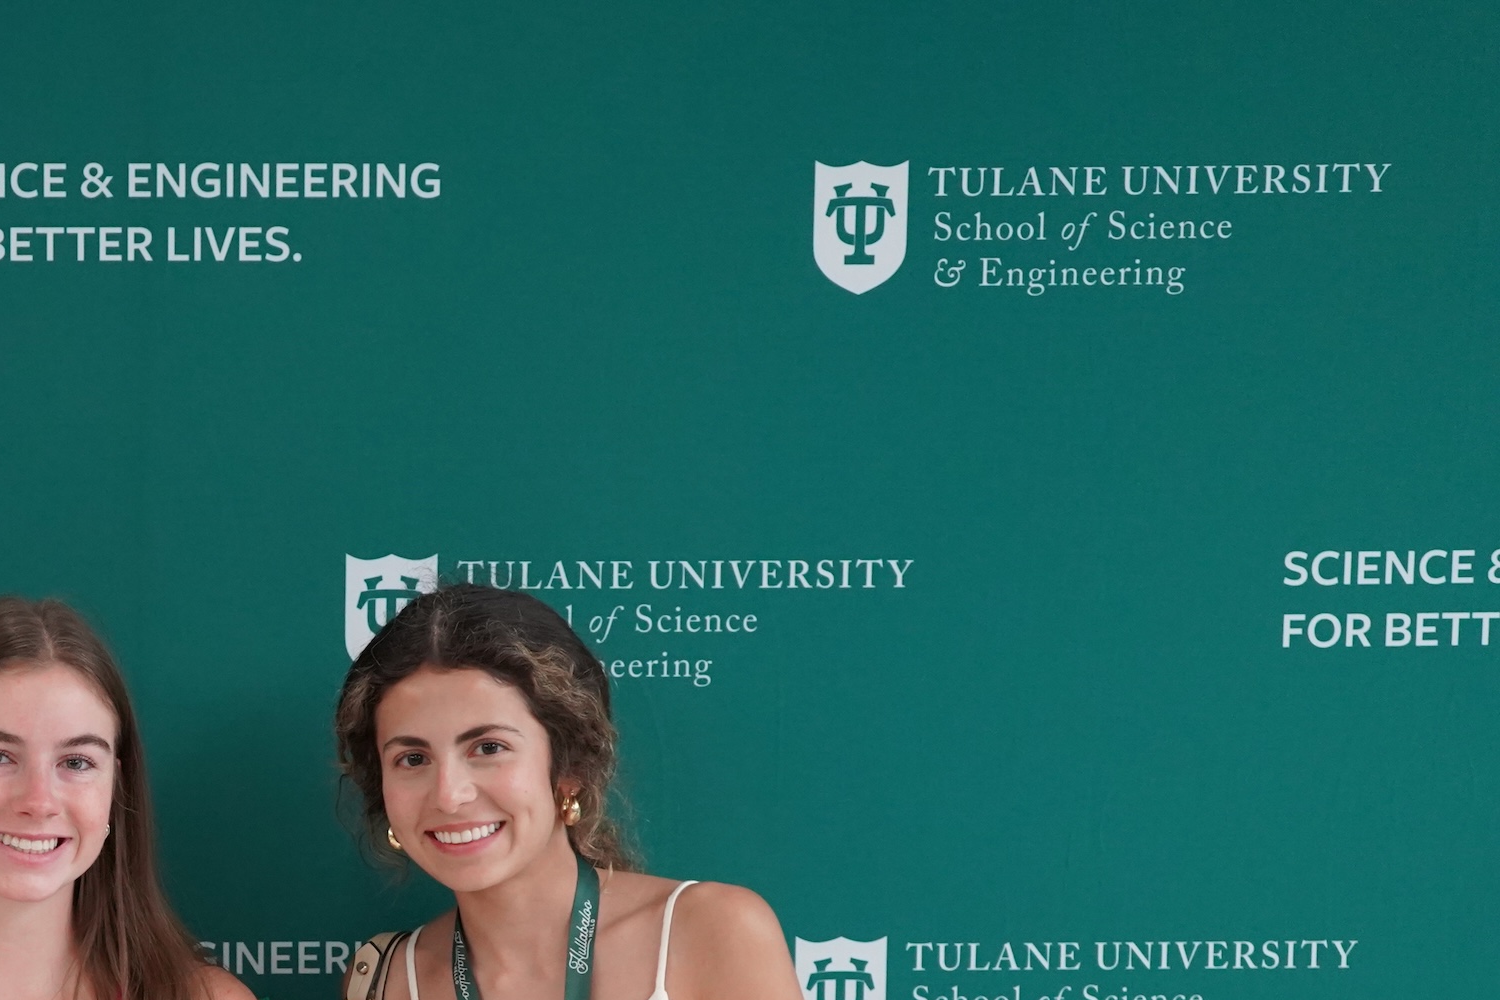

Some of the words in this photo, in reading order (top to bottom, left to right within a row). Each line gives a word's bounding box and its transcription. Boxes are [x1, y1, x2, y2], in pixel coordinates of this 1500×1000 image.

[80, 162, 114, 199] &
[128, 162, 441, 199] ENGINEERING
[927, 166, 1107, 197] TULANE
[1121, 162, 1392, 196] UNIVERSITY
[167, 225, 302, 263] LIVES.
[933, 211, 1047, 242] School
[1060, 211, 1098, 252] of
[1108, 210, 1232, 240] Science
[933, 257, 967, 288] &
[978, 257, 1186, 297] Engineering
[457, 560, 634, 590] TULANE
[648, 558, 914, 590] UNIVERSITY
[1283, 549, 1476, 587] SCIENCE
[588, 605, 625, 644] of
[635, 603, 758, 633] Science
[1282, 612, 1372, 649] FOR
[1384, 611, 1500, 647] BETT
[610, 651, 713, 688] eering
[905, 941, 1081, 972] TULANE
[1094, 939, 1358, 971] UNIVERSITY
